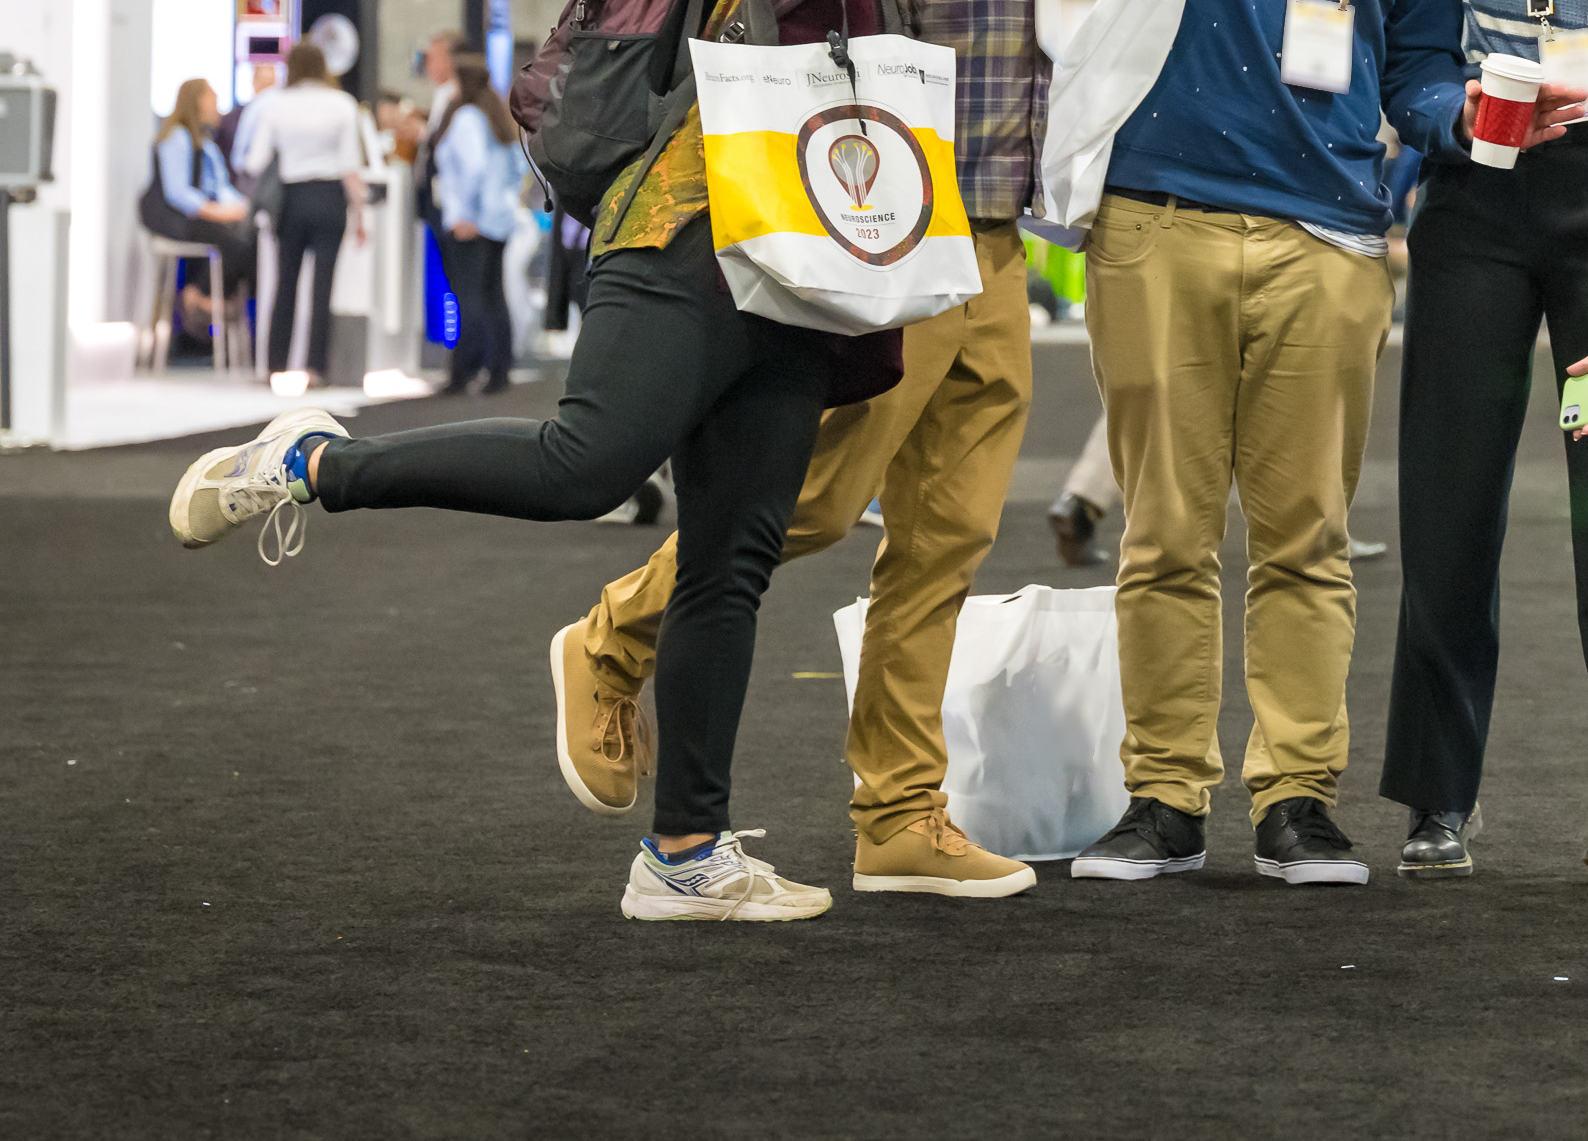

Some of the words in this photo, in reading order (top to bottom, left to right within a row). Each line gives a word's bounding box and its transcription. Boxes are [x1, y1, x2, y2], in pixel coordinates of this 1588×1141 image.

[763, 74, 792, 86] eNeuro
[806, 67, 861, 88] JNeurosi
[840, 212, 896, 224] NEUROSCIENCE
[855, 227, 880, 240] 2023
